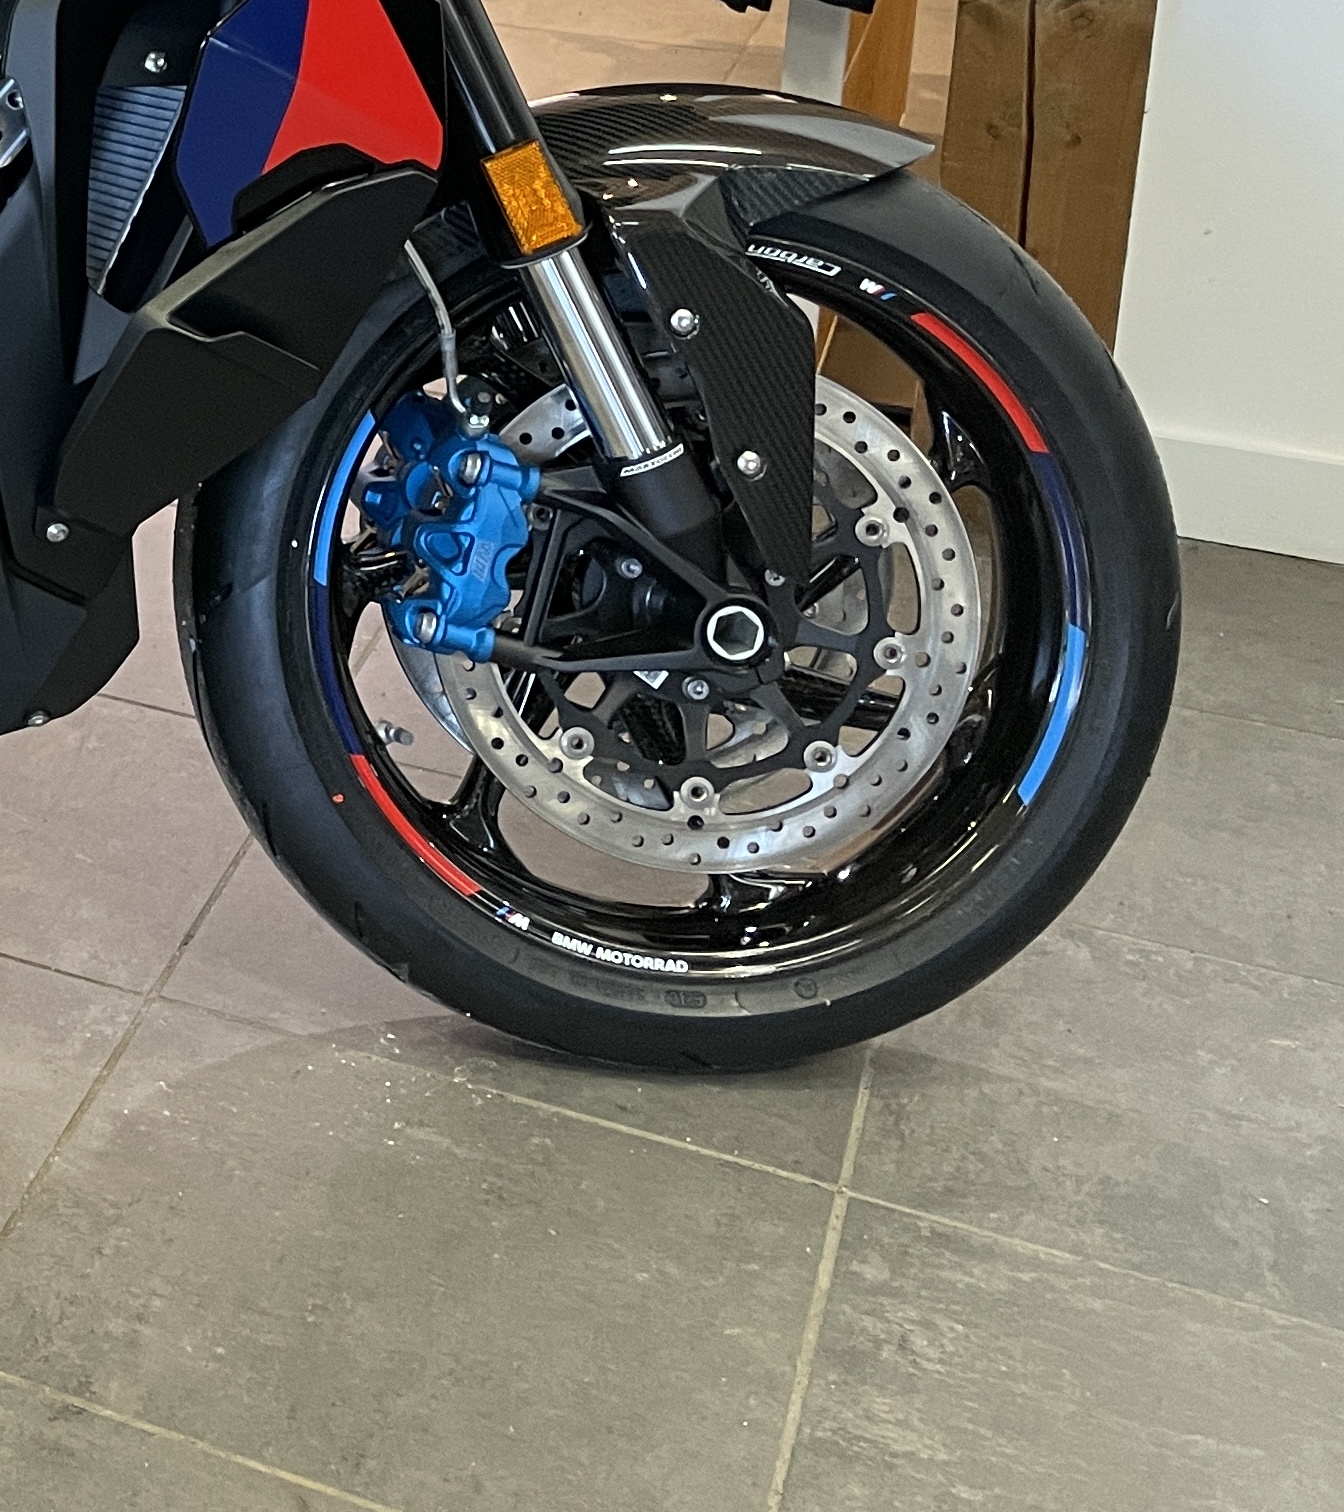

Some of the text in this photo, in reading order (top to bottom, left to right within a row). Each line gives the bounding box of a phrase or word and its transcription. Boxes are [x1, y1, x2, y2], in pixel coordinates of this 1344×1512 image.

[744, 243, 842, 277] Carbon
[551, 931, 594, 956] BMW
[595, 946, 690, 974] MOTORRAD
